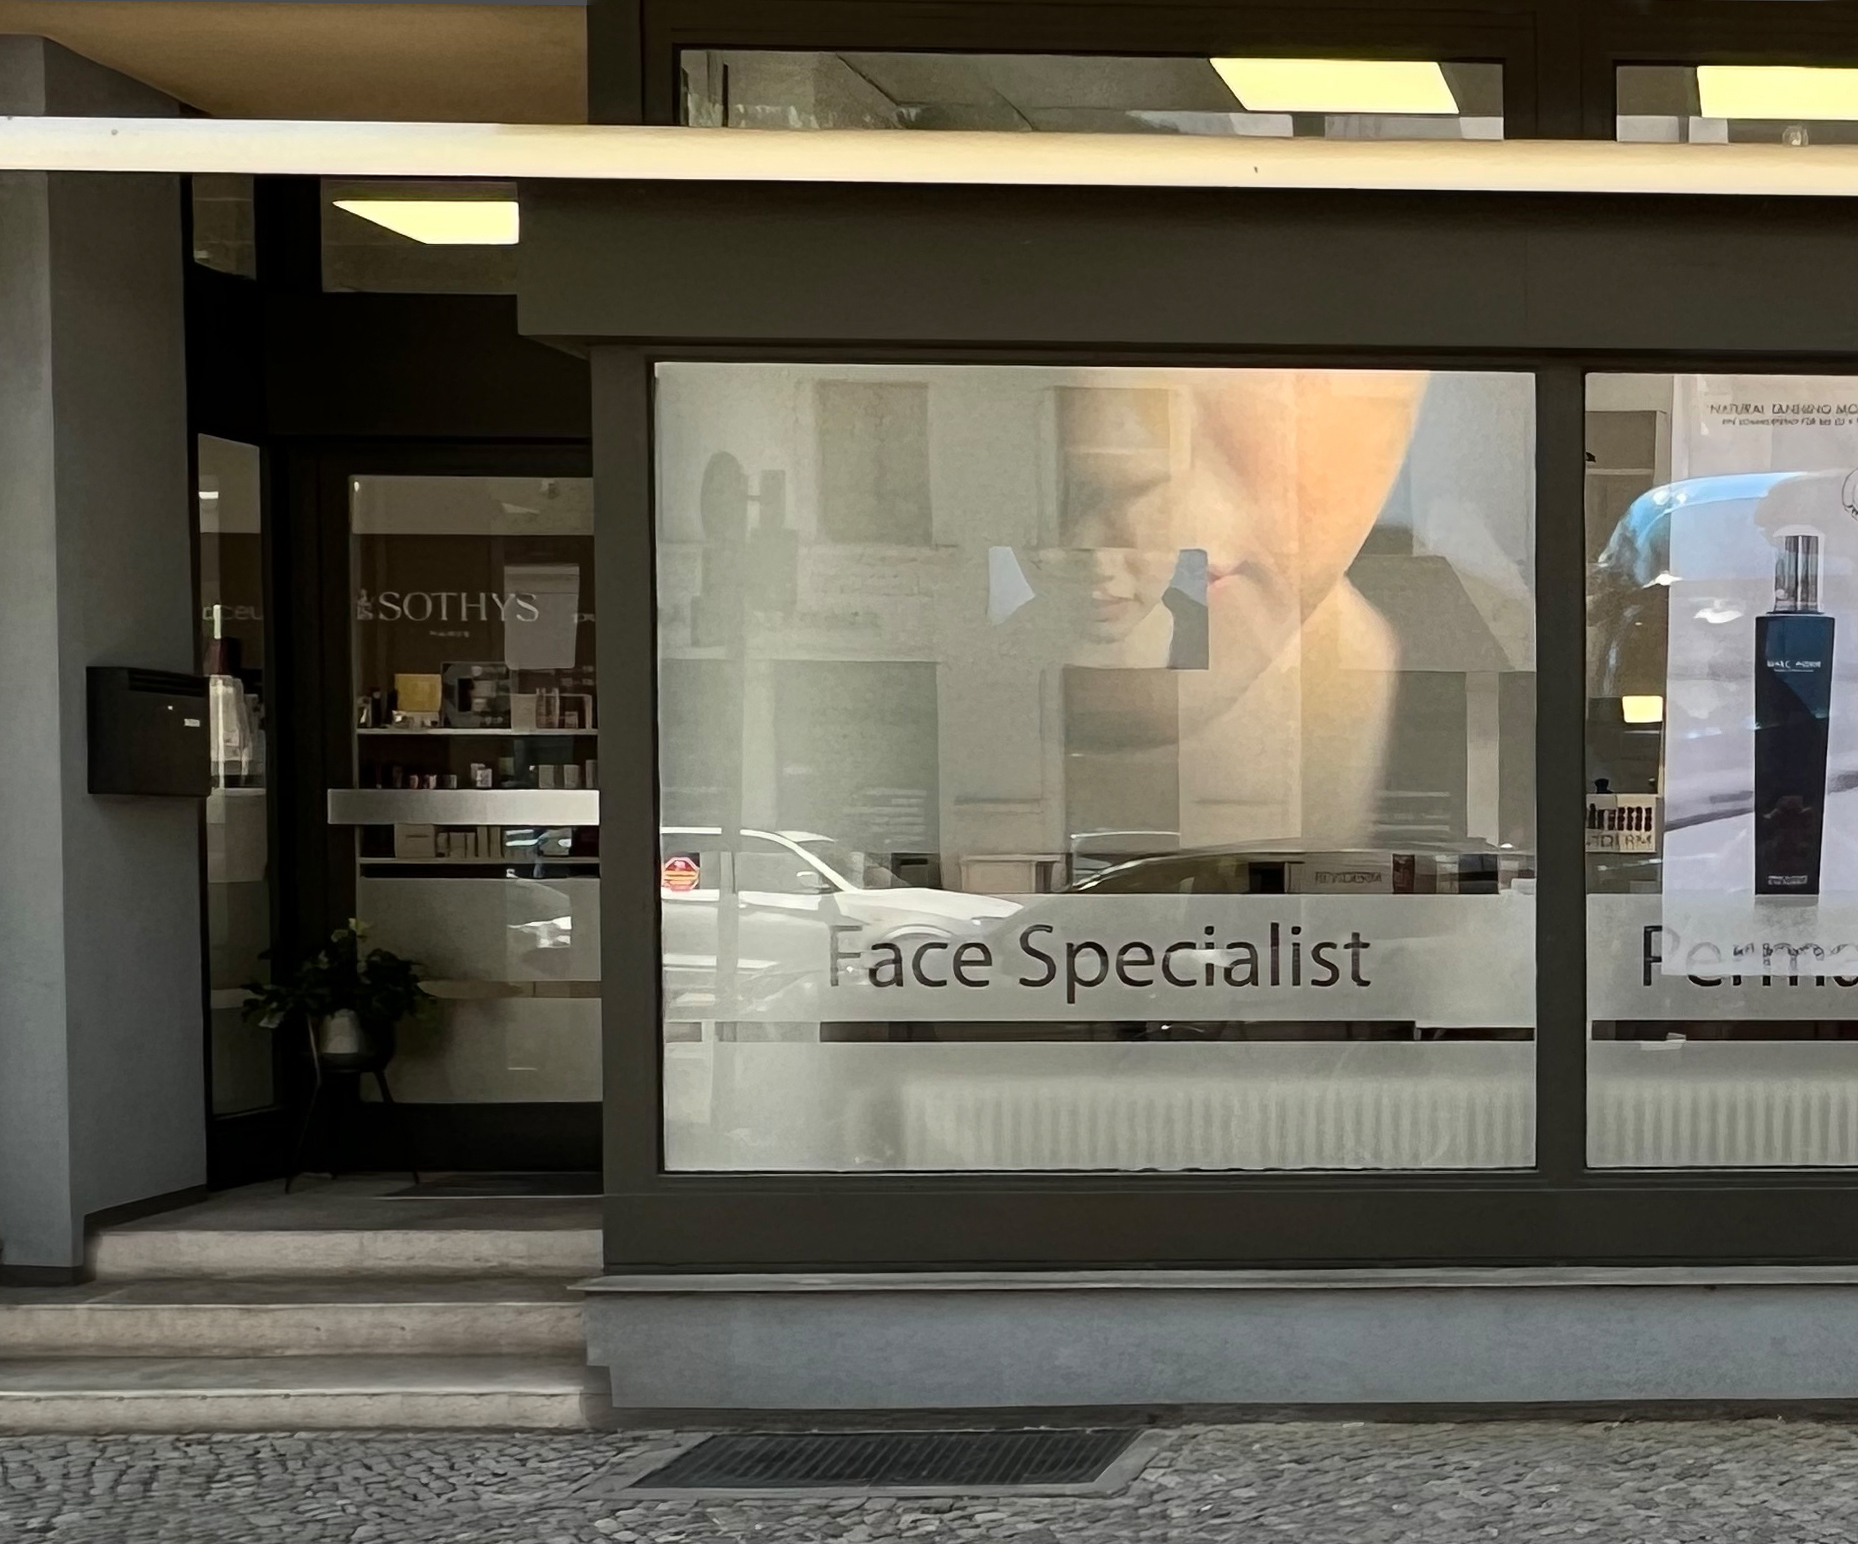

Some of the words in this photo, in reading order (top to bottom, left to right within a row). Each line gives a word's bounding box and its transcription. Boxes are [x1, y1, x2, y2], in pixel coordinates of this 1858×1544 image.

[378, 591, 539, 621] SOTHYS
[830, 925, 993, 988] Face
[1019, 921, 1372, 1005] Specialist
